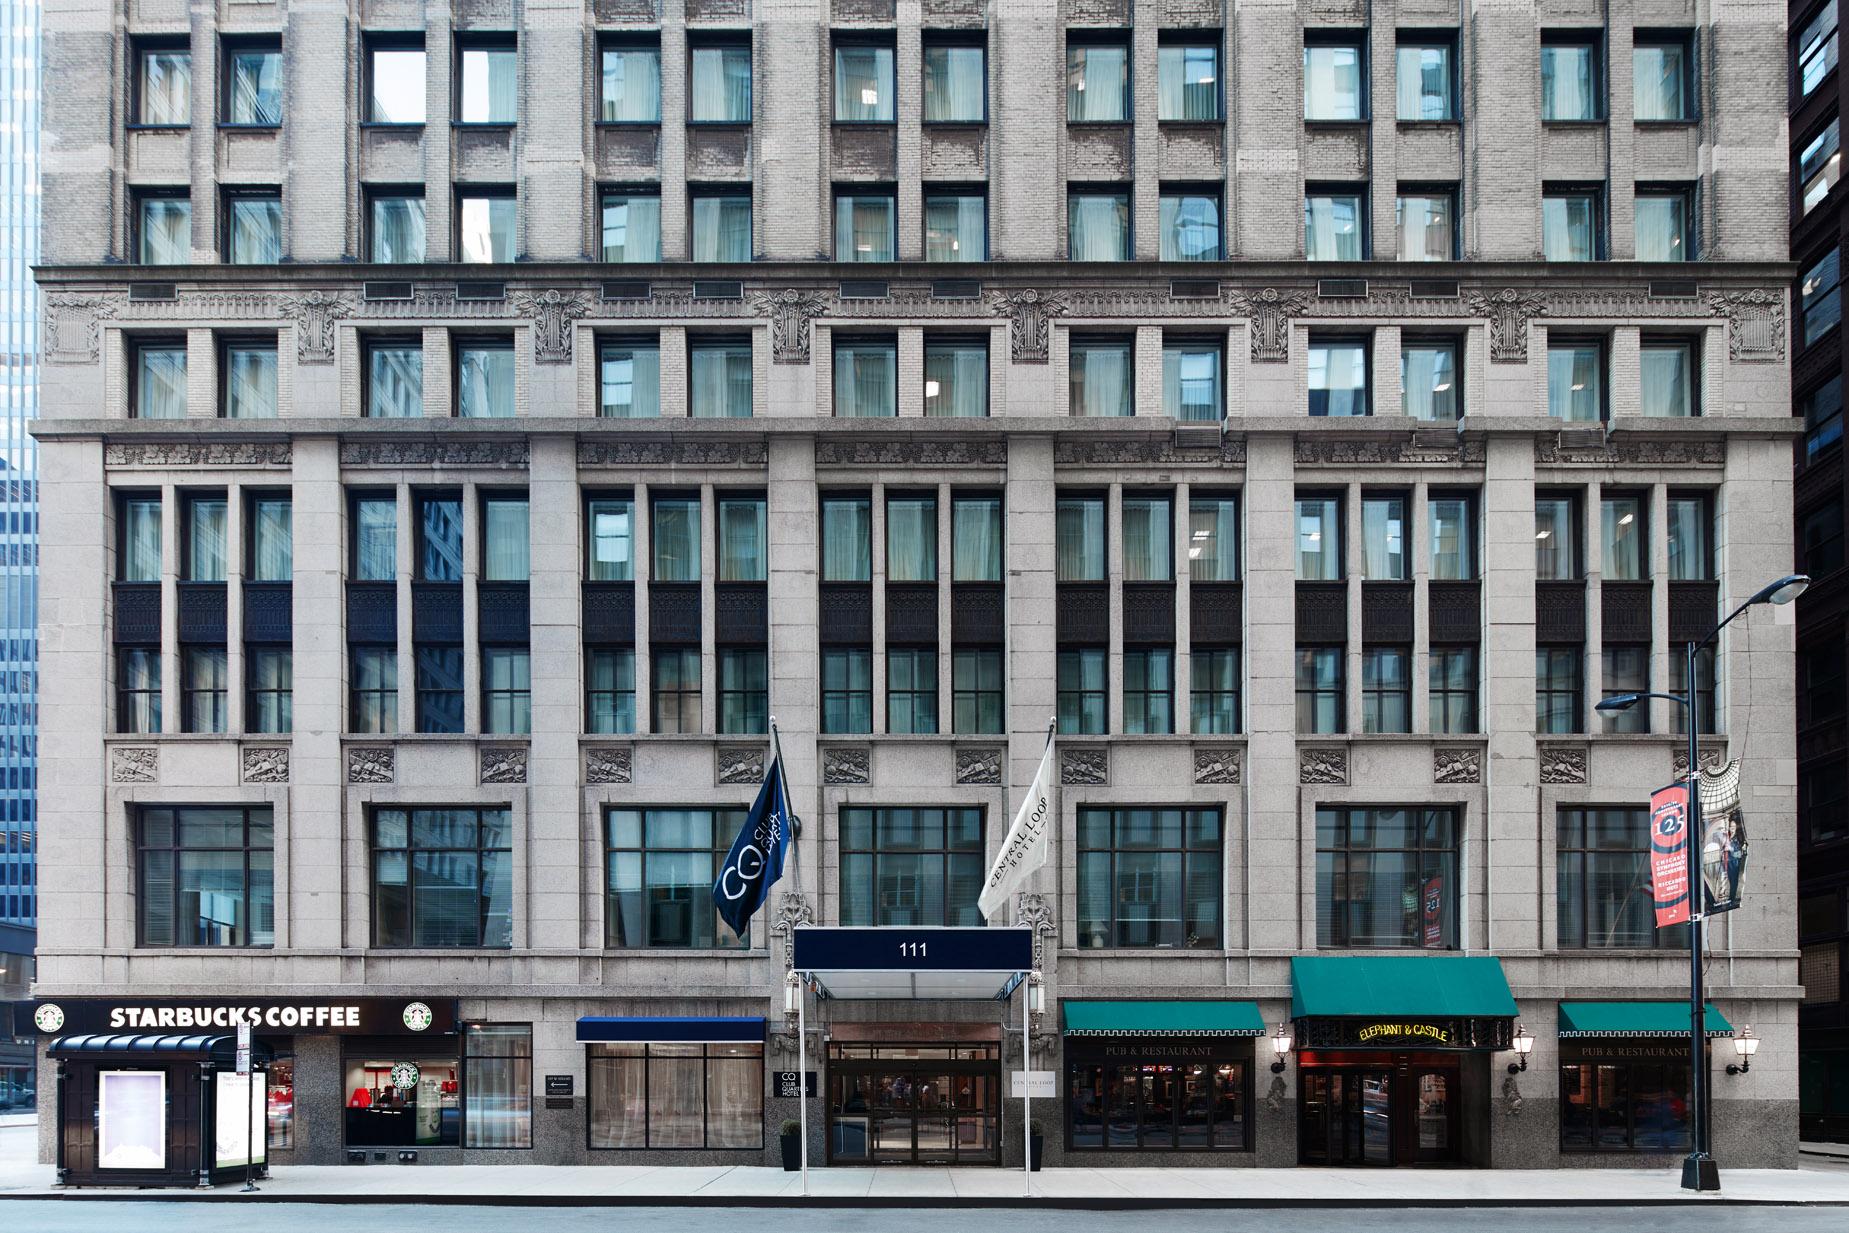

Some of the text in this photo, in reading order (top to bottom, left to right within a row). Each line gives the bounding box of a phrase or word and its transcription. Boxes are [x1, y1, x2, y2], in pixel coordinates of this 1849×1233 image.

[1655, 815, 1685, 835] 125
[991, 797, 1047, 887] CENTRAL LOOP
[1010, 828, 1041, 868] HOTEL
[1656, 855, 1685, 865] CHICAGO
[1656, 860, 1686, 872] SYMPHONY
[722, 844, 766, 900] CQ
[899, 942, 926, 957] 111
[109, 1006, 360, 1028] STARBUCKS COFFEE
[1360, 1024, 1449, 1042] ELEPHANT & CASTLE
[1106, 1047, 1213, 1056] PUB & RESTAURANT
[1582, 1047, 1689, 1056] PUB & RESTAURANT
